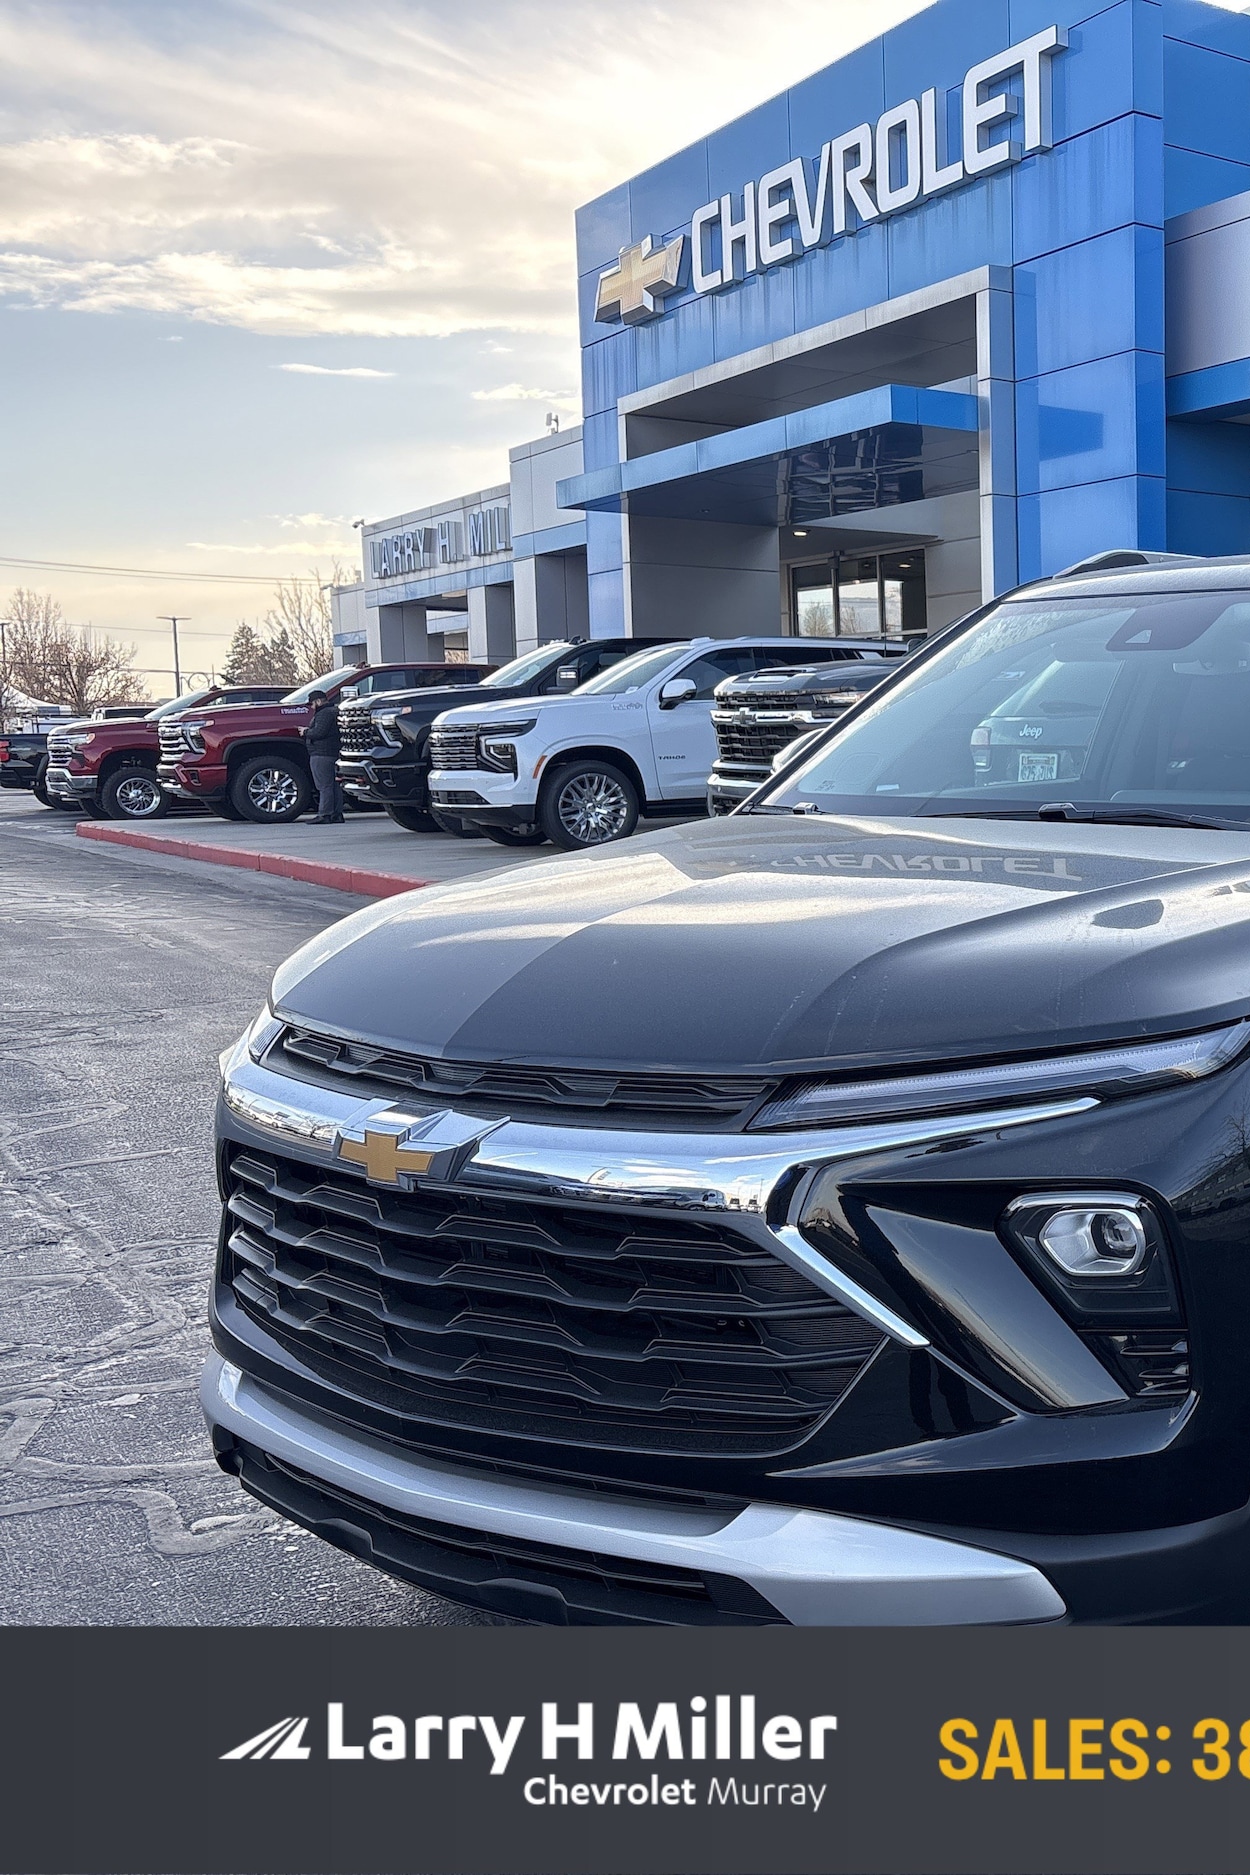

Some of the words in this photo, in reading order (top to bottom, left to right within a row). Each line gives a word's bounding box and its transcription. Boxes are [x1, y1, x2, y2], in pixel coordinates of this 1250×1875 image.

[691, 24, 1068, 295] CHEVROLET
[370, 528, 426, 579] LARRY
[1020, 724, 1042, 738] Jeep
